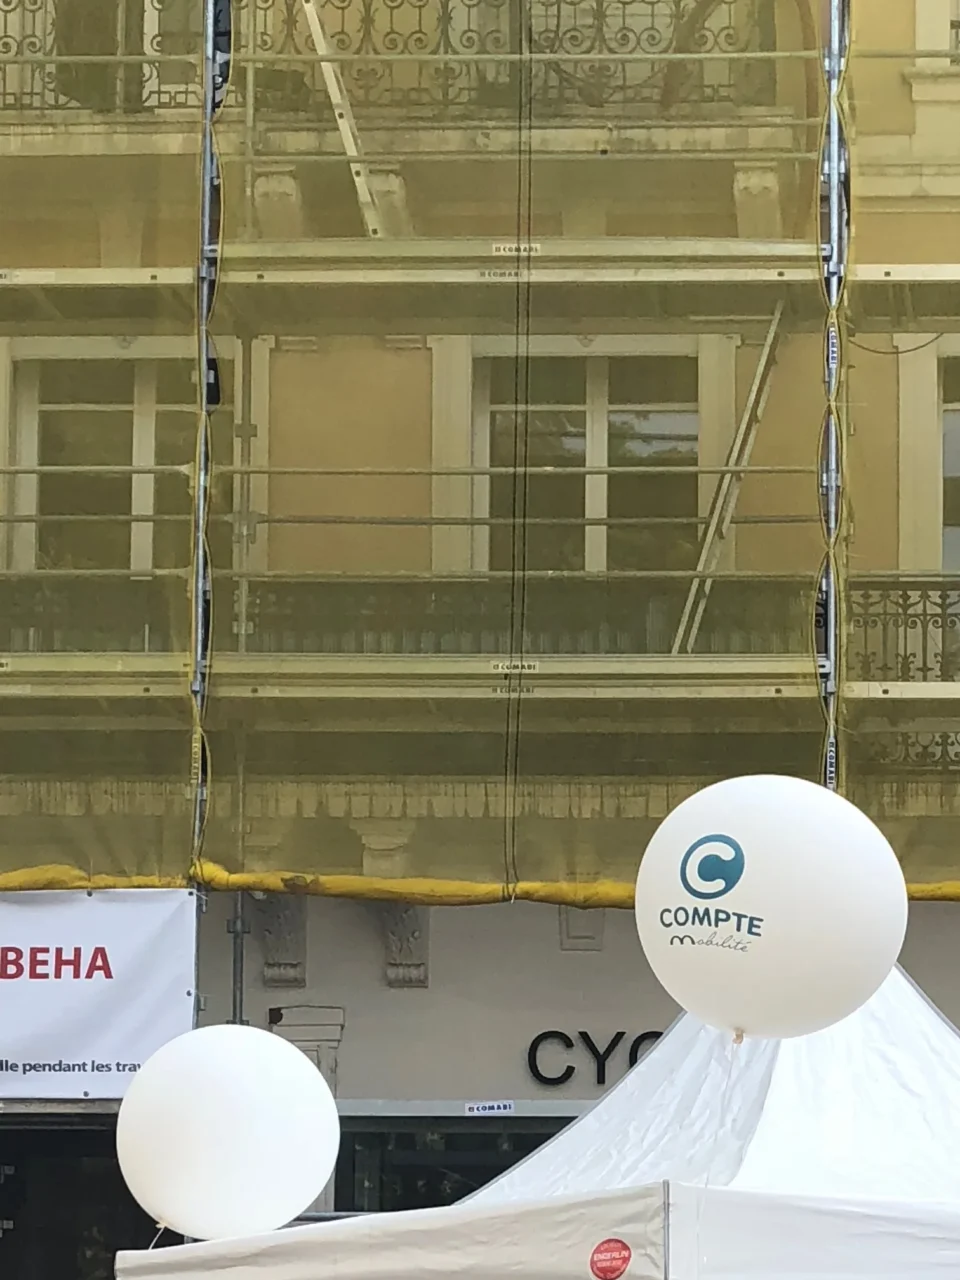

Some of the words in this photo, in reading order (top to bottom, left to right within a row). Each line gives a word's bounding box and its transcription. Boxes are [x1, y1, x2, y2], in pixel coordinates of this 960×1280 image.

[659, 906, 764, 938] COMPTE
[0, 946, 114, 980] BEHA
[22, 1059, 88, 1075] pendant
[91, 1059, 112, 1073] les
[475, 1104, 512, 1113] COMABI
